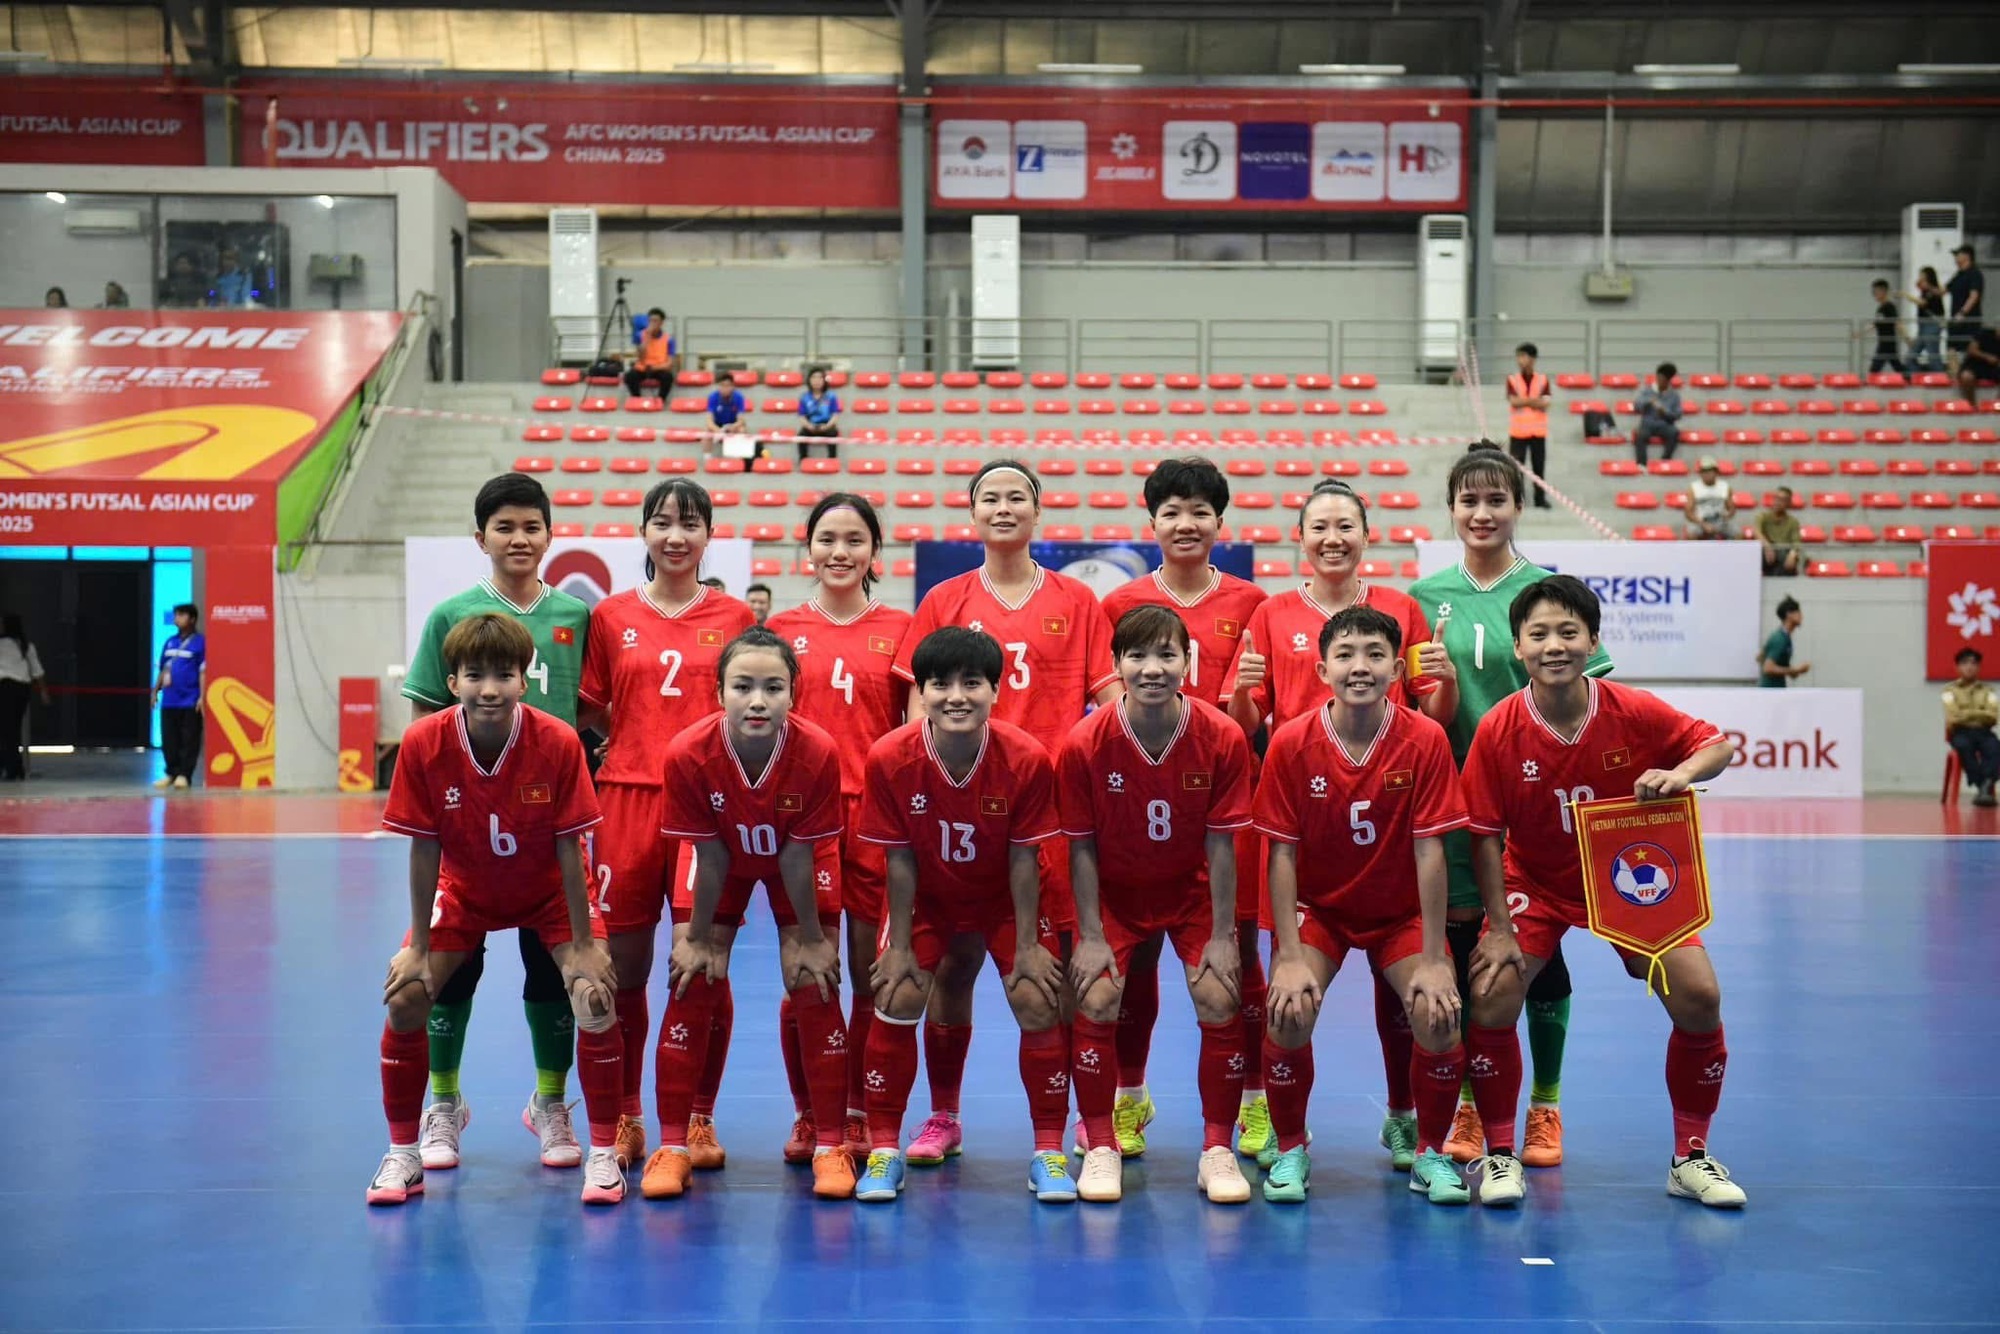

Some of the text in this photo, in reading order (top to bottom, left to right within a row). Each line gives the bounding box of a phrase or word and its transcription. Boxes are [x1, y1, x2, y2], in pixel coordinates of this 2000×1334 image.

[78, 117, 138, 134] ASIAN
[141, 119, 183, 135] CUP
[262, 118, 549, 162] QUALIFIERS
[564, 123, 876, 143] AFC WOMEN'S FUTSAL ASIAN CUP
[564, 147, 665, 163] CHINA 2025
[1241, 151, 1309, 164] NOVOTEL
[70, 493, 146, 511] FUTSAL
[150, 494, 209, 511] ASIAN
[213, 494, 255, 511] CUP
[1474, 623, 1485, 670] 1
[1630, 629, 1686, 643] Systems
[660, 650, 683, 696] 2
[831, 658, 854, 704] 4
[1005, 642, 1030, 690] 3
[1722, 727, 1840, 769] Bank
[490, 813, 517, 857] 6
[736, 823, 777, 856] 10
[939, 820, 976, 862] 13
[1147, 800, 1171, 841] 8
[1350, 800, 1376, 845] 5
[1591, 811, 1685, 832] VIETNAM FOOTBALL FEDERATION
[597, 864, 611, 912] 2
[1637, 887, 1657, 898] VFF
